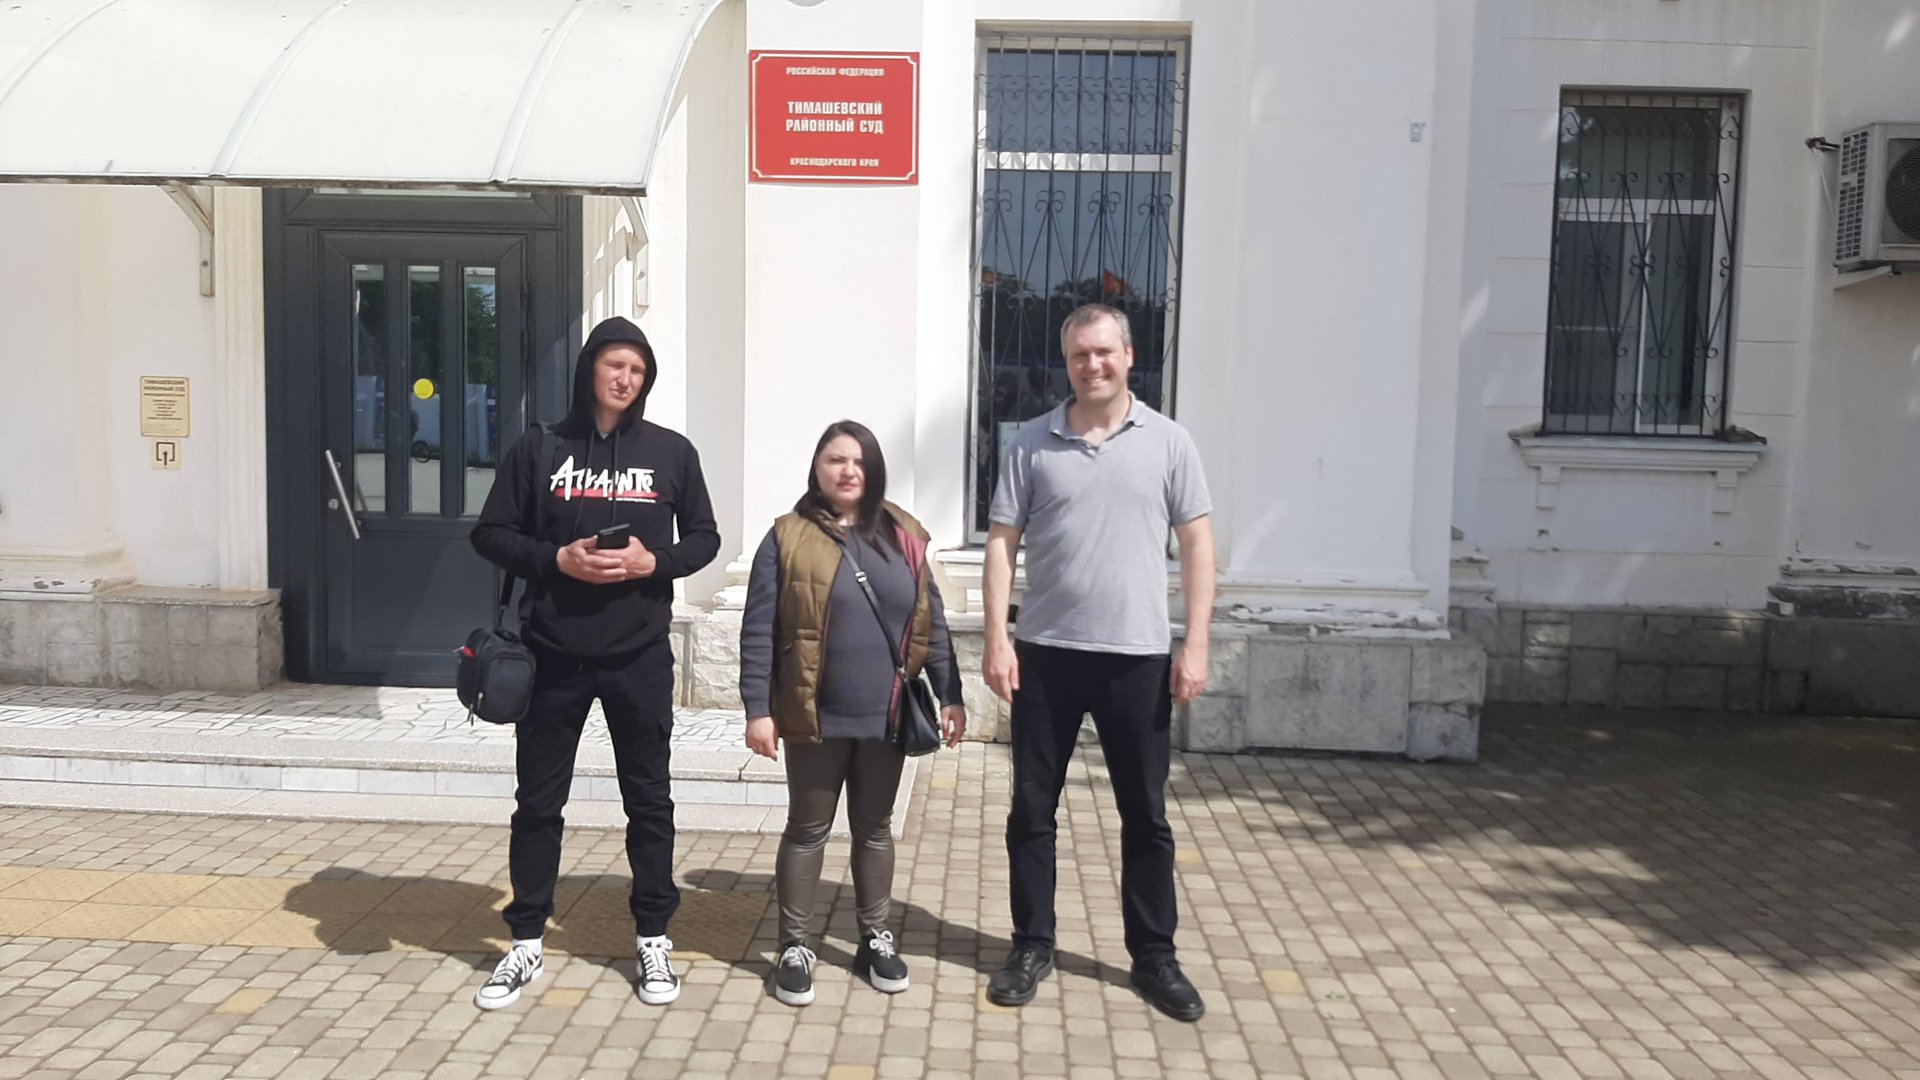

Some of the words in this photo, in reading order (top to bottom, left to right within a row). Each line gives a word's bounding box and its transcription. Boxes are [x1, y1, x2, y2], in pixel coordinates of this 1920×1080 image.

[786, 67, 836, 76] РОССИЙСКАЯ
[787, 101, 883, 115] ТИМАШЕВСКИЙ
[785, 118, 855, 132] РАЙОННЫЙ
[859, 120, 884, 134] СУД
[790, 157, 857, 167] КРАСНОДАРСКОГО
[859, 158, 880, 167] КРАЯ
